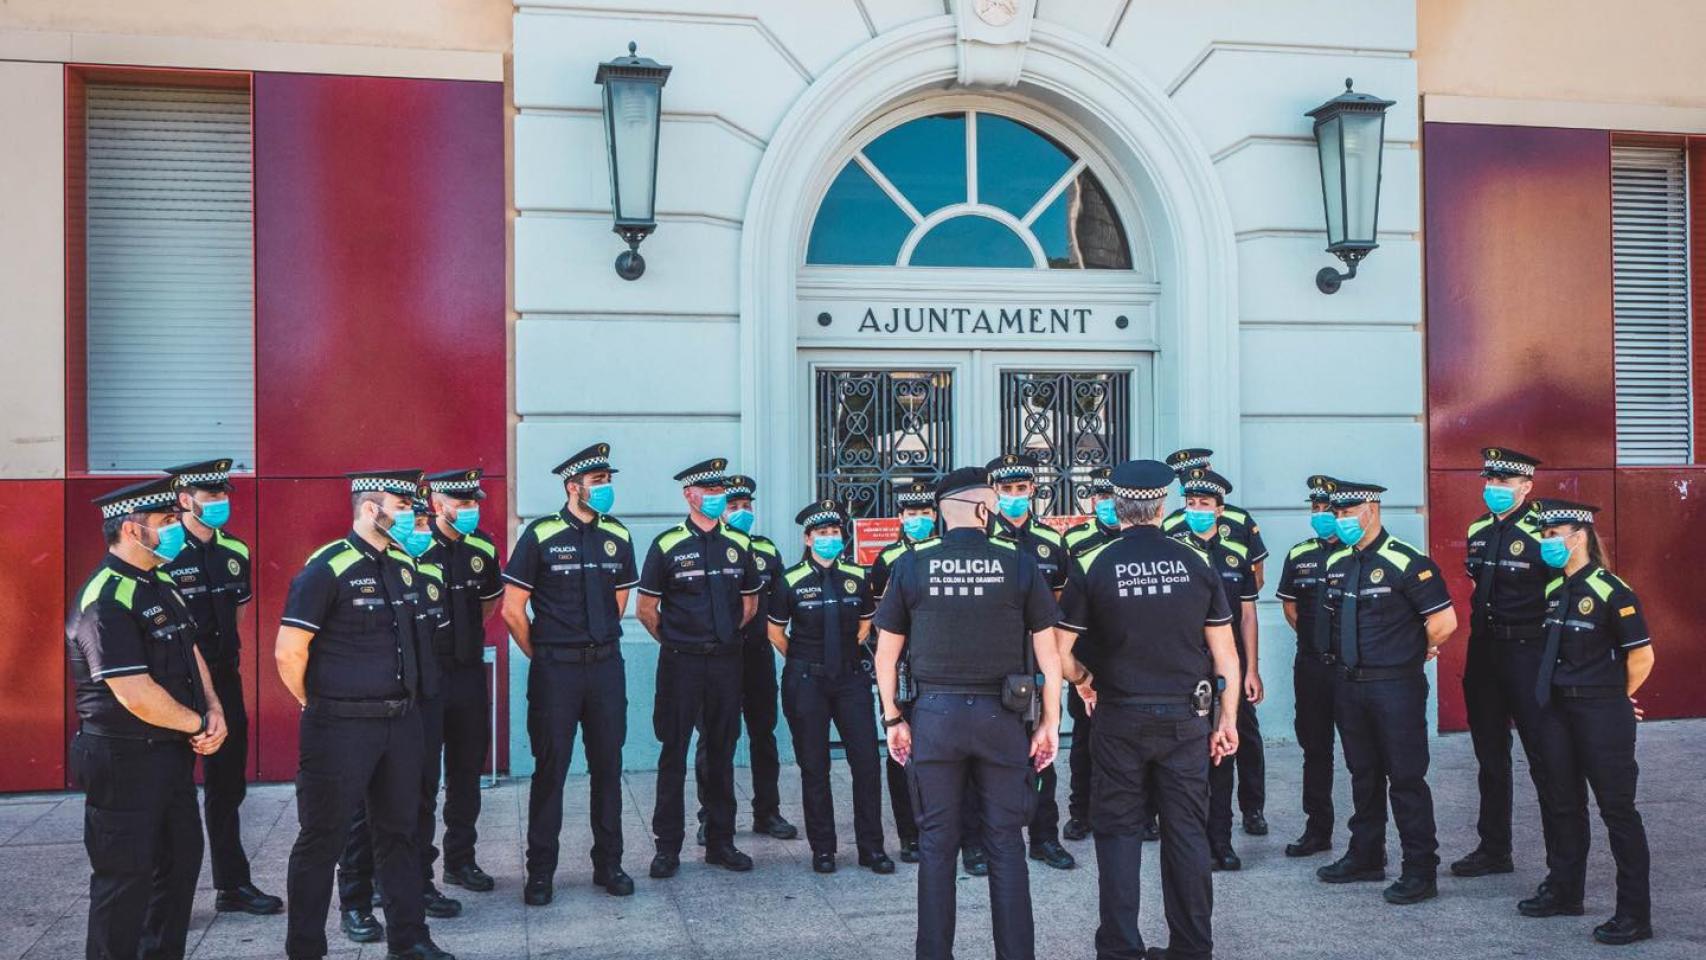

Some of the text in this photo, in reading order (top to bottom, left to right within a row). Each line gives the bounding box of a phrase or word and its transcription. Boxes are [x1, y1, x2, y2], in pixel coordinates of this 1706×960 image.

[858, 307, 1092, 334] AJUNTAMENT
[929, 559, 1004, 574] POLICIA
[1115, 560, 1188, 578] POLICIA
[1161, 575, 1190, 583] local
